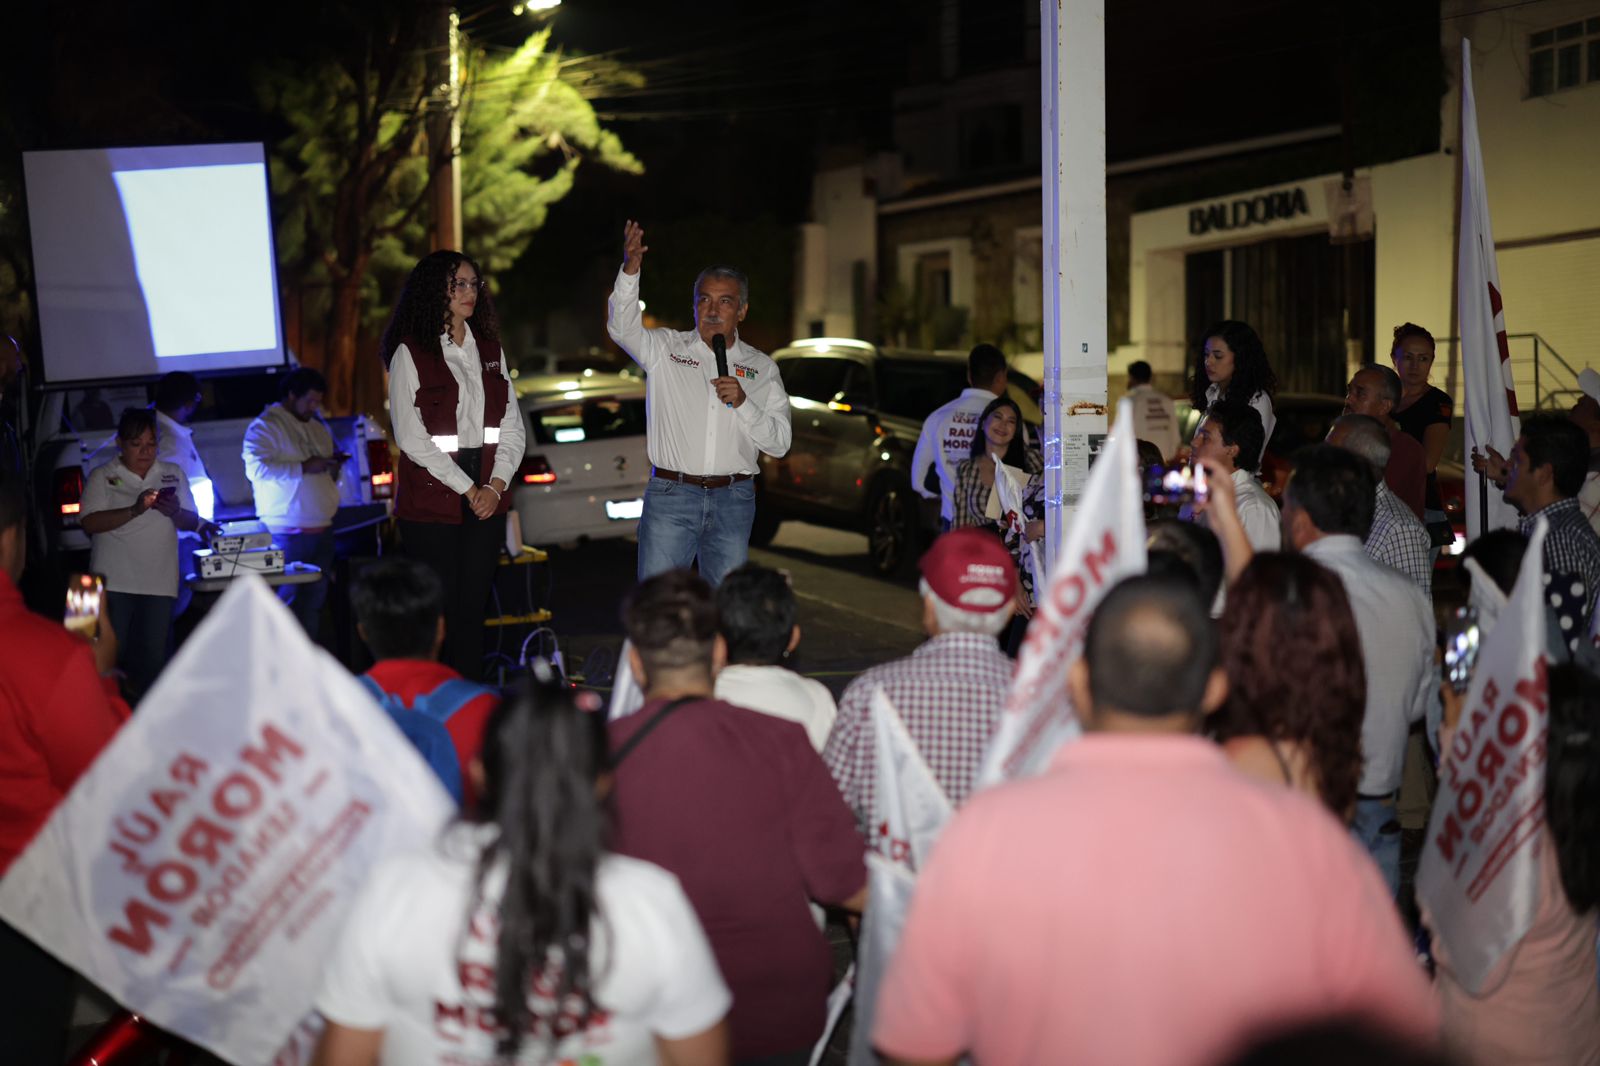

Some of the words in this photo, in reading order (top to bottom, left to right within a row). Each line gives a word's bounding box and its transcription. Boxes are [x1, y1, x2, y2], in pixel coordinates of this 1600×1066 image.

[1189, 187, 1307, 234] BALDORIA
[669, 353, 700, 367] MORÓN
[733, 363, 760, 375] morena
[949, 426, 976, 438] RAÚ
[943, 440, 976, 449] MOR
